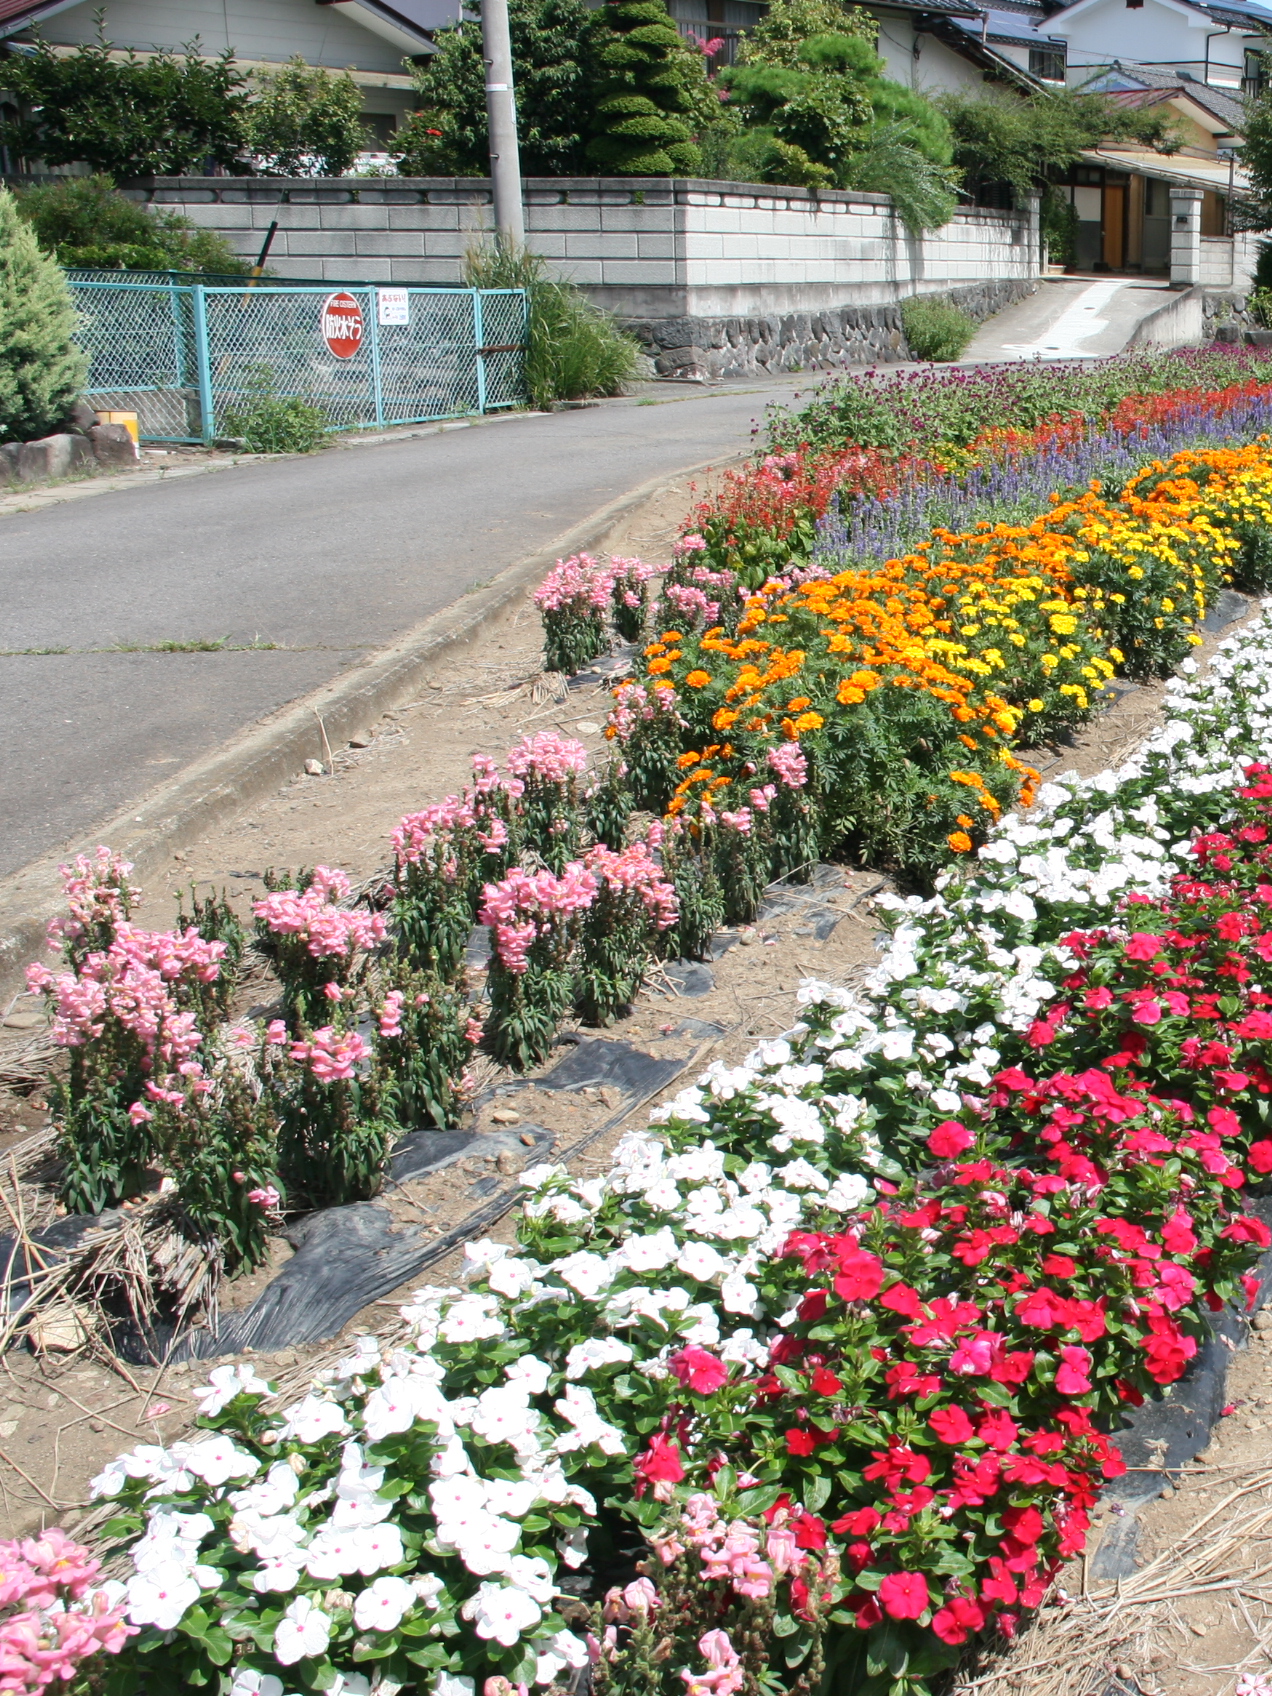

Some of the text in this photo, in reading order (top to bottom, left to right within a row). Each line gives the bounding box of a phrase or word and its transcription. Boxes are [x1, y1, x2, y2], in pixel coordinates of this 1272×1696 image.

[326, 314, 361, 340] 防火水そう
